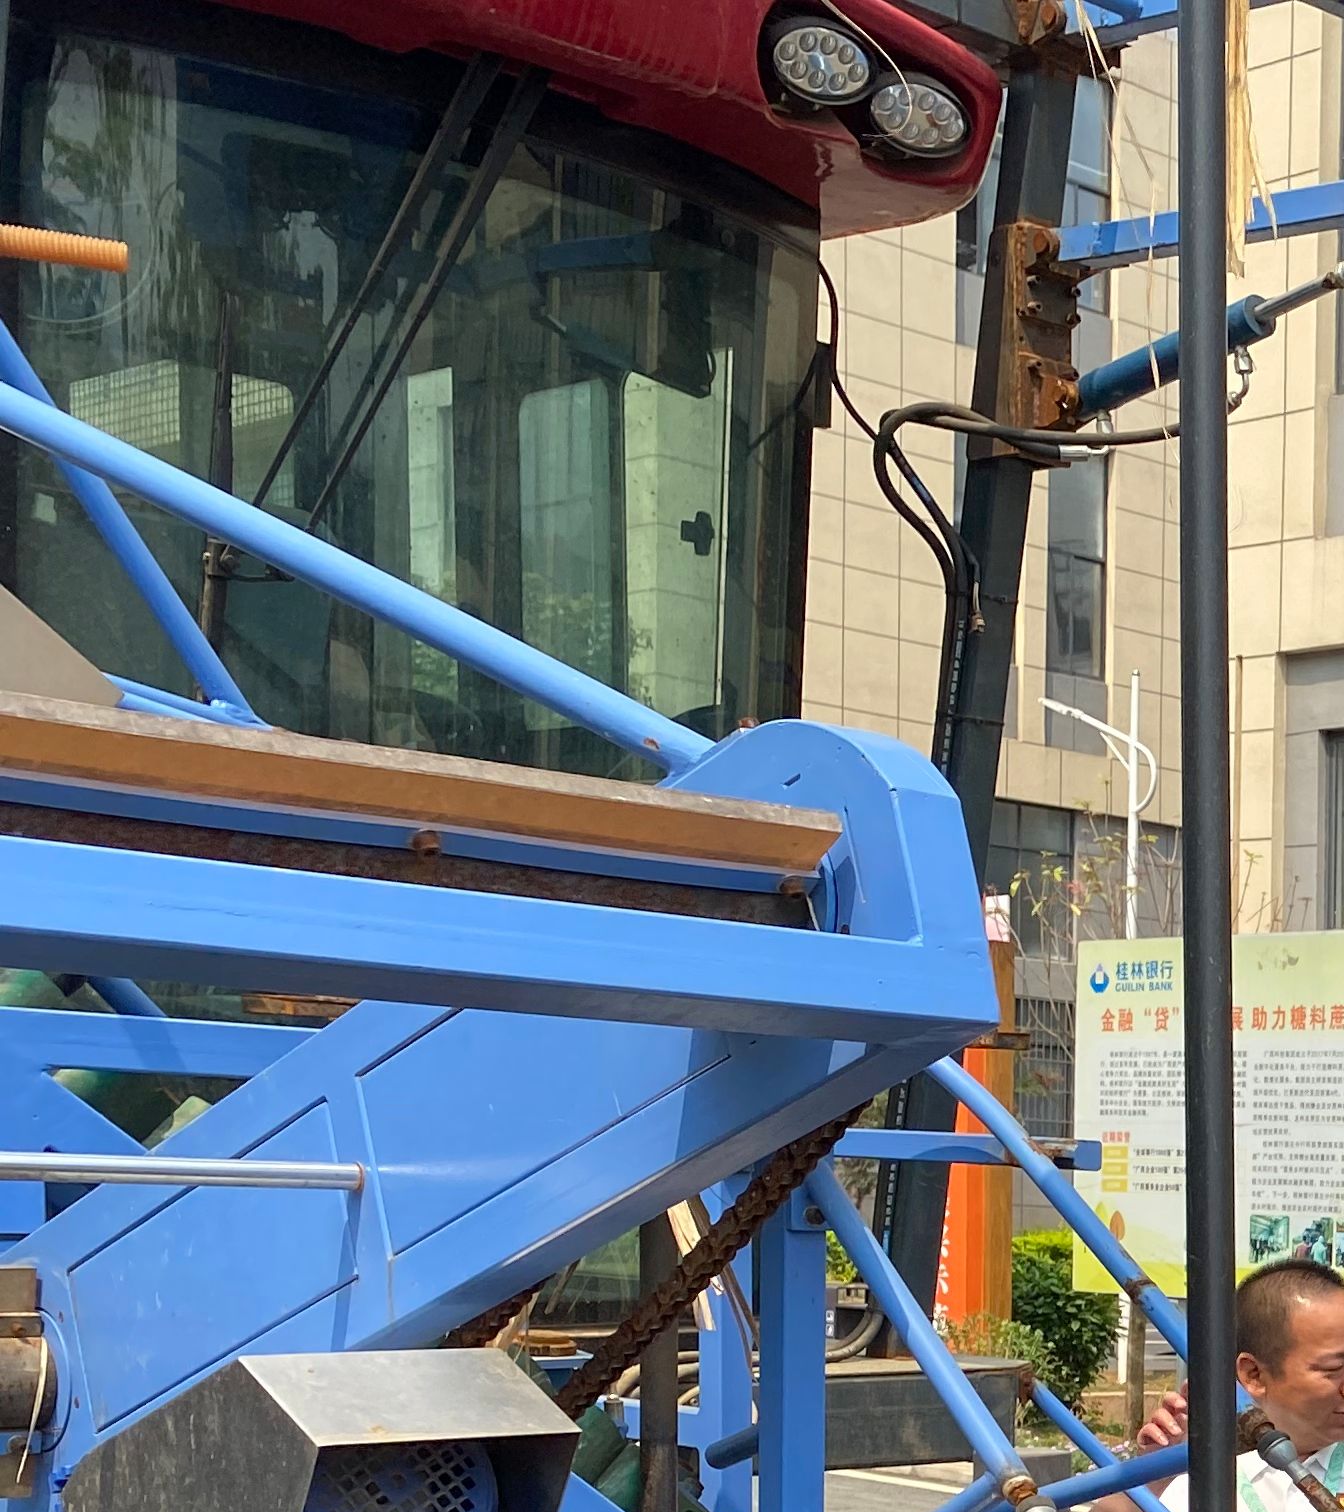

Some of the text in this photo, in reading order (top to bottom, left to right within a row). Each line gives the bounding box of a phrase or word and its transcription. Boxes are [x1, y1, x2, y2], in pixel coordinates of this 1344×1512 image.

[1115, 960, 1174, 980] 桂林银行
[1115, 982, 1173, 992] GUILIN BANK
